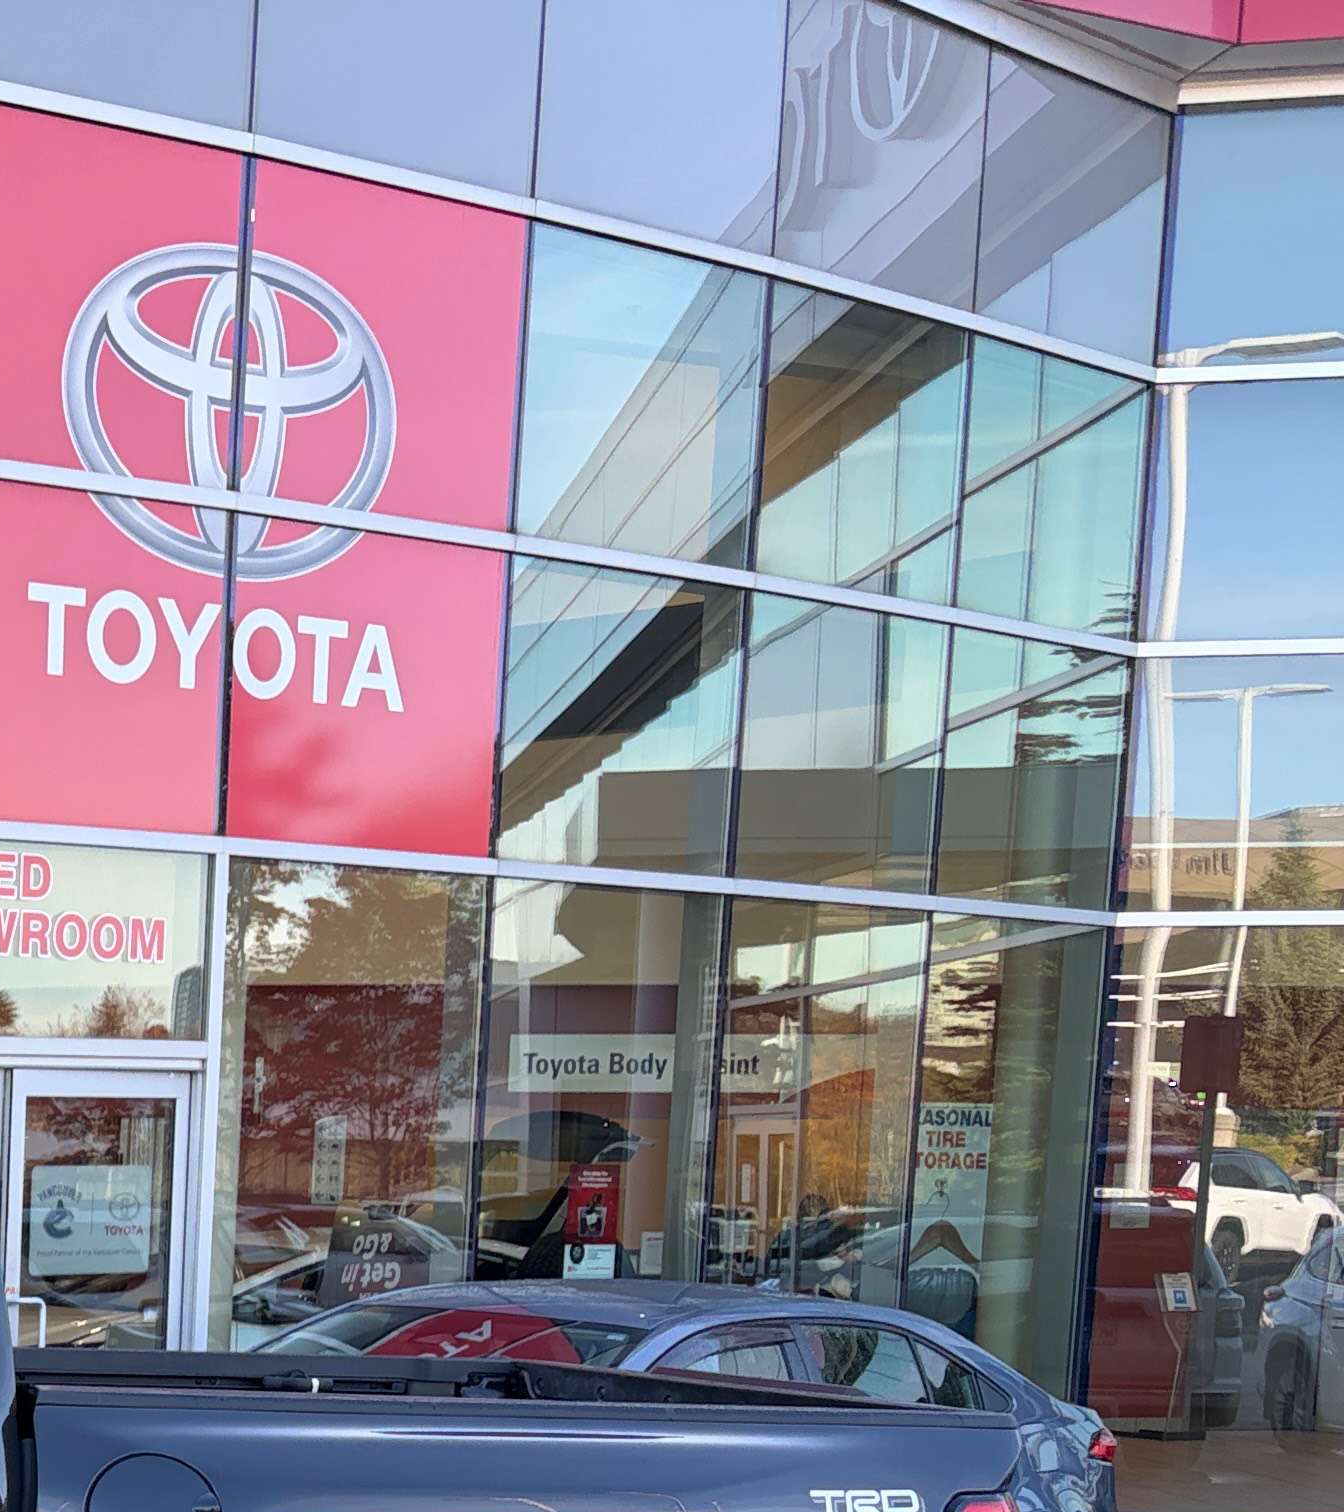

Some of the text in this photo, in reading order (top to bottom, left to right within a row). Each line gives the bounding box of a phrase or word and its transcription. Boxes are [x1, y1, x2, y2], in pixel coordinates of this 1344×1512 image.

[27, 581, 405, 713] TOYOTA
[523, 1052, 600, 1077] Toyota
[609, 1050, 669, 1080] Body
[926, 1130, 967, 1148] TIRE
[104, 1224, 143, 1236] TOYOTA
[340, 1261, 401, 1292] Get in
